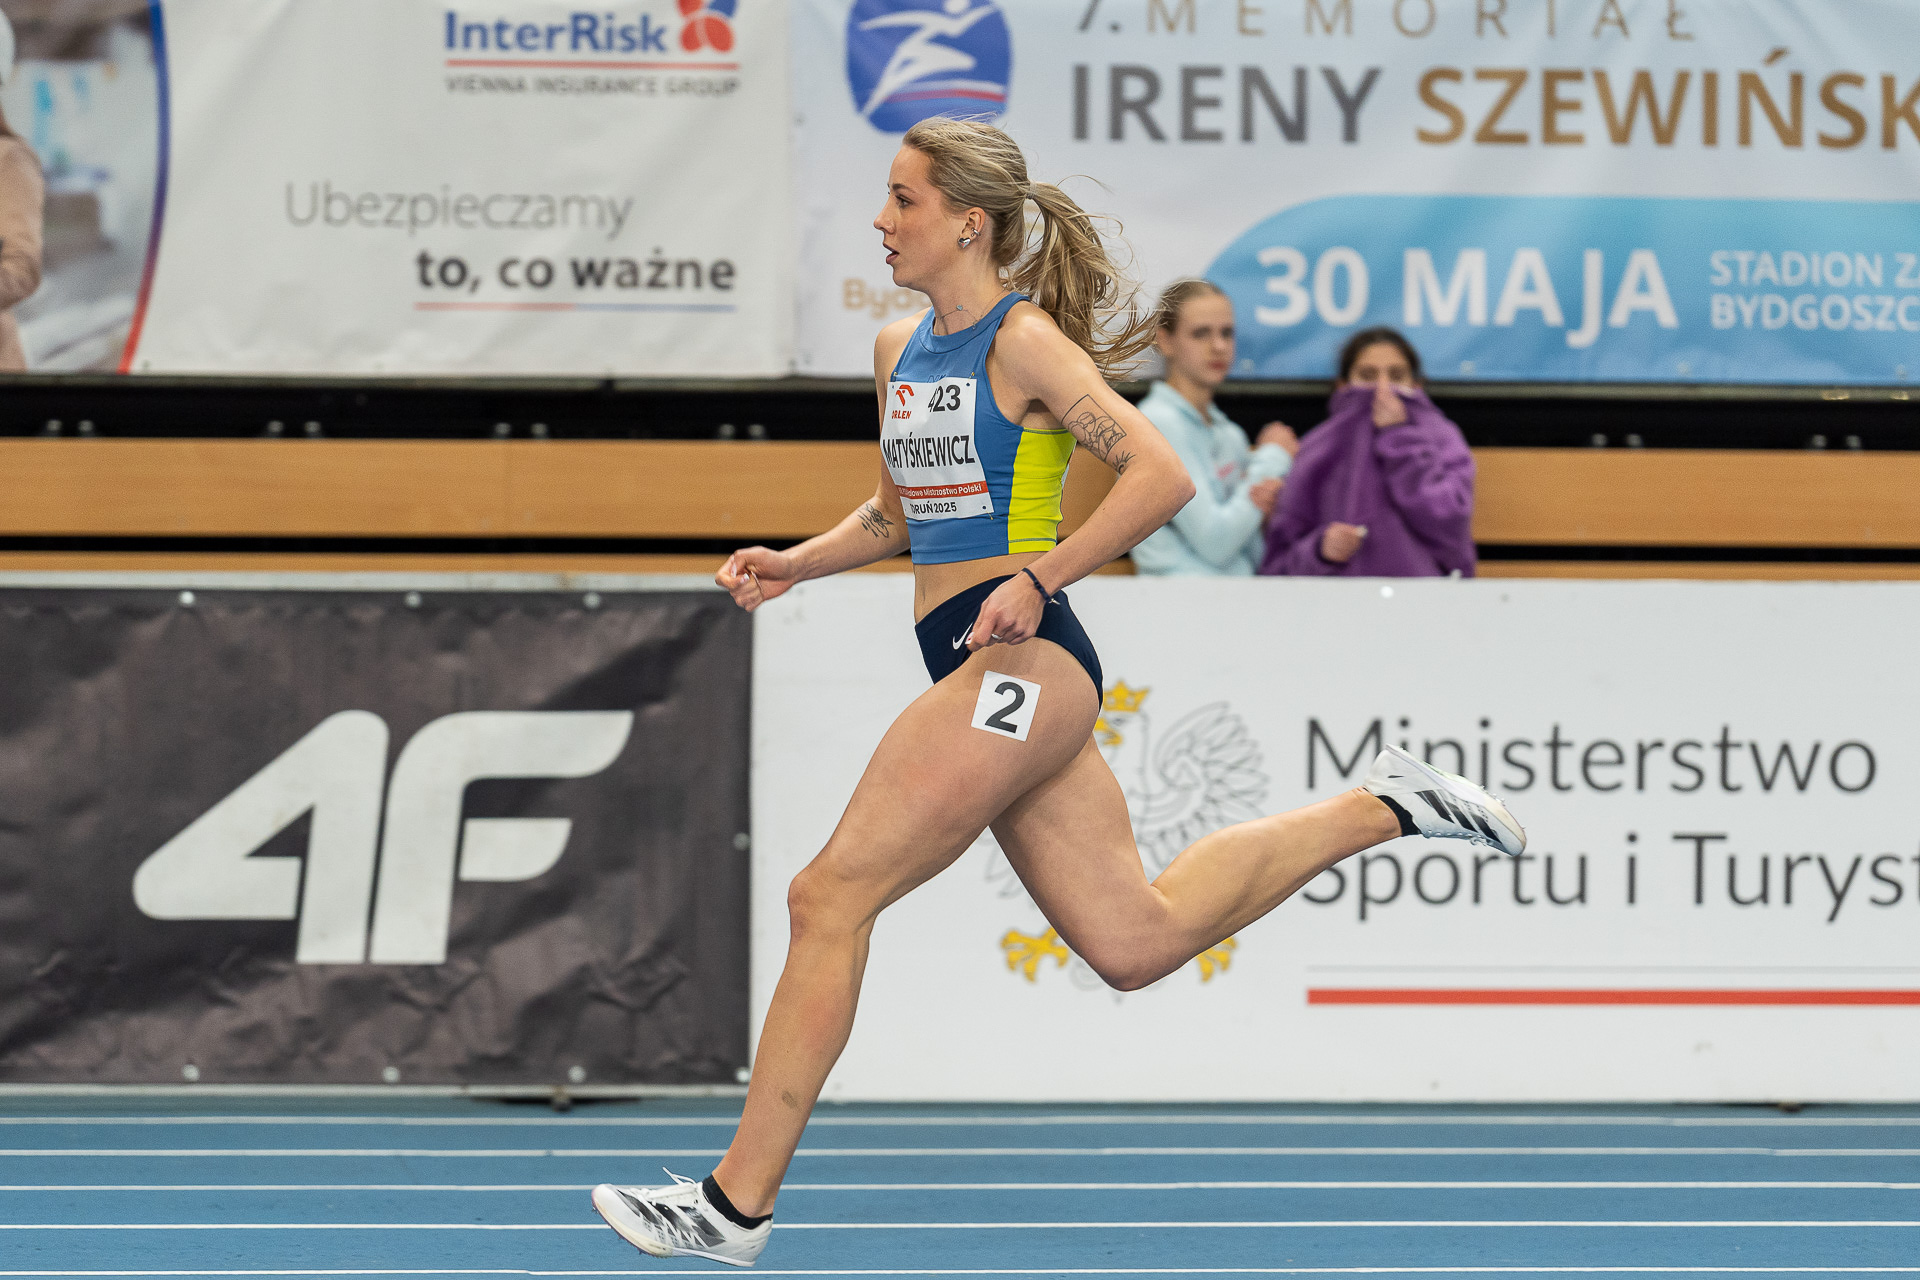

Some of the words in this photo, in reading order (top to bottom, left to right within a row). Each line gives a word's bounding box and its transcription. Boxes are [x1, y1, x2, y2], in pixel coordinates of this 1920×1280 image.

[445, 11, 668, 53] InterRisk
[1146, 0, 1696, 41] MEMORIAŁ
[446, 76, 527, 93] VIENNA
[534, 77, 659, 95] INSURANCE
[667, 78, 741, 97] GROUP
[1073, 64, 1383, 143] IRENY
[1415, 47, 1920, 150] SZEWIŃSK
[285, 180, 634, 240] Ubezpieczamy
[415, 250, 482, 294] to,
[499, 257, 554, 289] co
[571, 247, 738, 290] ważne
[1710, 250, 1884, 288] STADION
[1255, 246, 1370, 328] 30
[1403, 248, 1679, 348] MAJA
[928, 384, 961, 412] 423
[883, 432, 975, 468] MATYŚKIEWICZ
[933, 501, 957, 514] 2025
[958, 483, 982, 494] Polski
[985, 681, 1026, 734] 2
[133, 709, 635, 965] 4F
[1625, 832, 1639, 905] i
[1672, 834, 1920, 923] Turys
